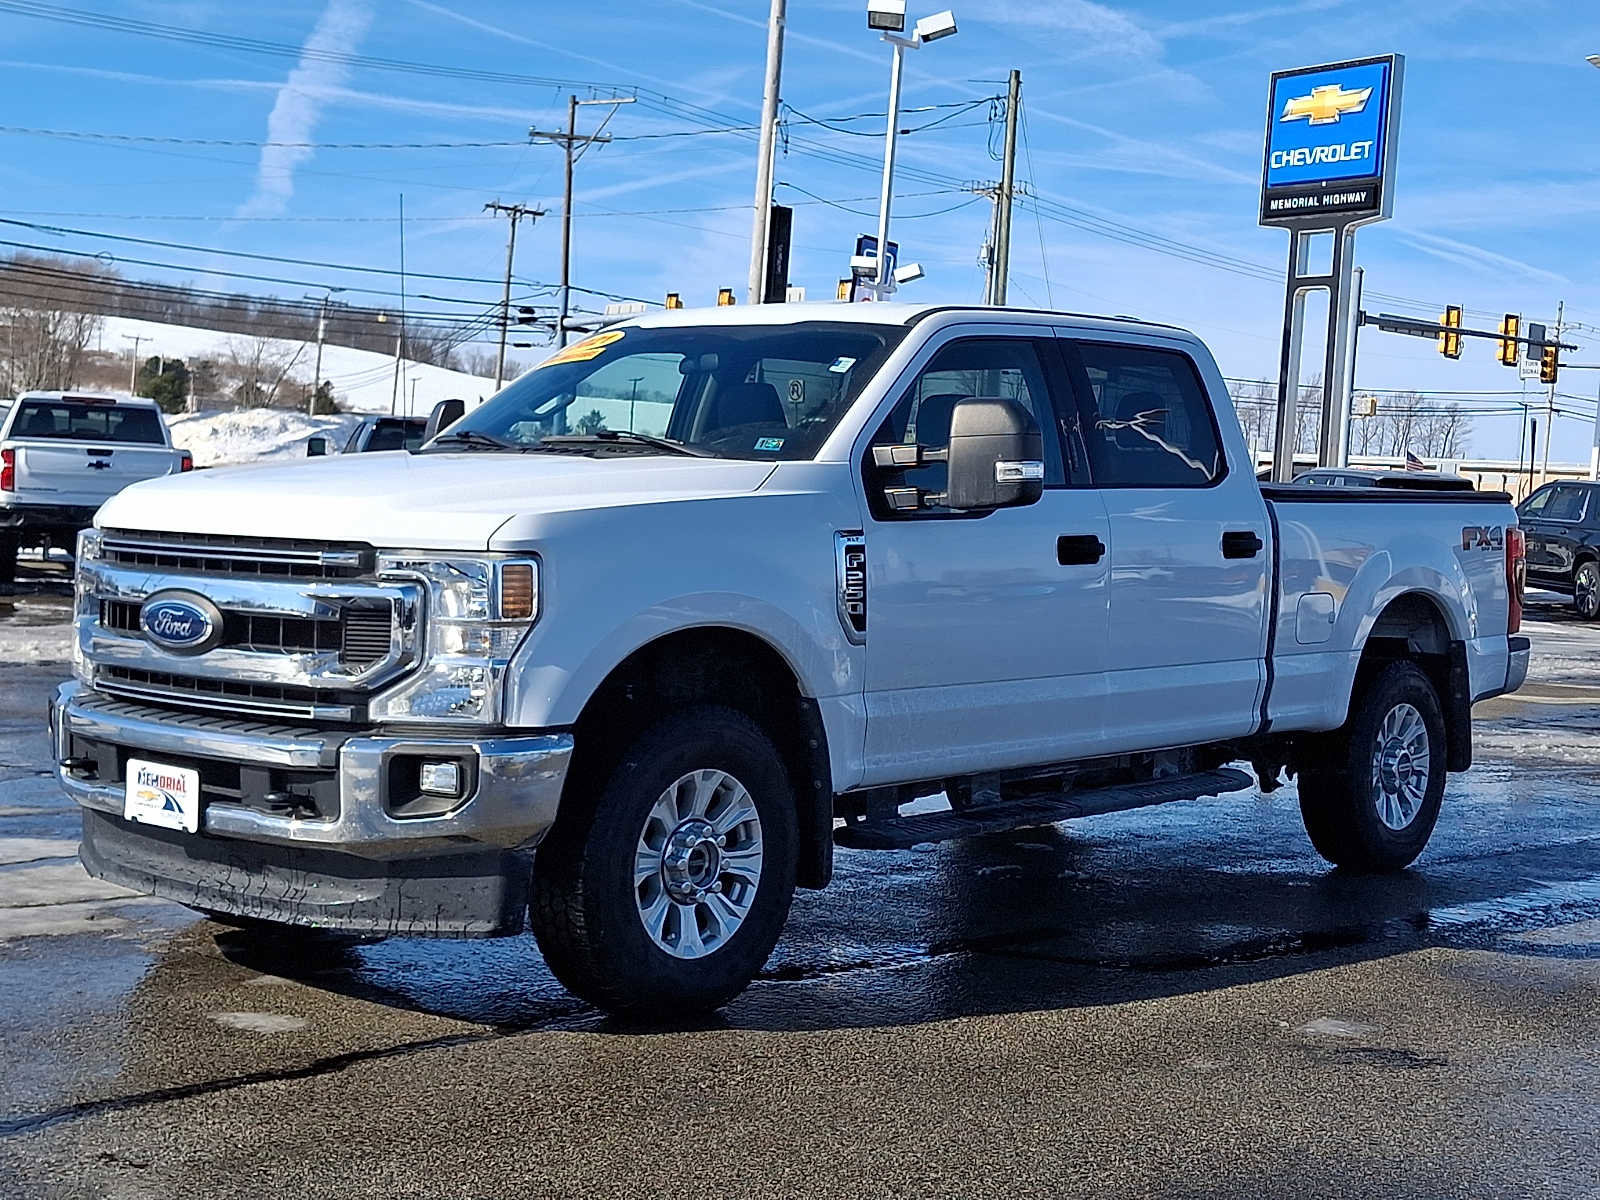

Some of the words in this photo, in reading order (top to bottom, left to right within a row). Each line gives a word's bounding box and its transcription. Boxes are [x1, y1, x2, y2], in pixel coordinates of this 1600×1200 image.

[1271, 140, 1374, 169] CHEVROLET
[1270, 196, 1320, 210] MEMORIAL
[1322, 191, 1367, 206] HIGHWAY
[1462, 526, 1503, 551] FX4
[154, 608, 193, 637] Ford
[137, 771, 186, 793] MEMORIAL
